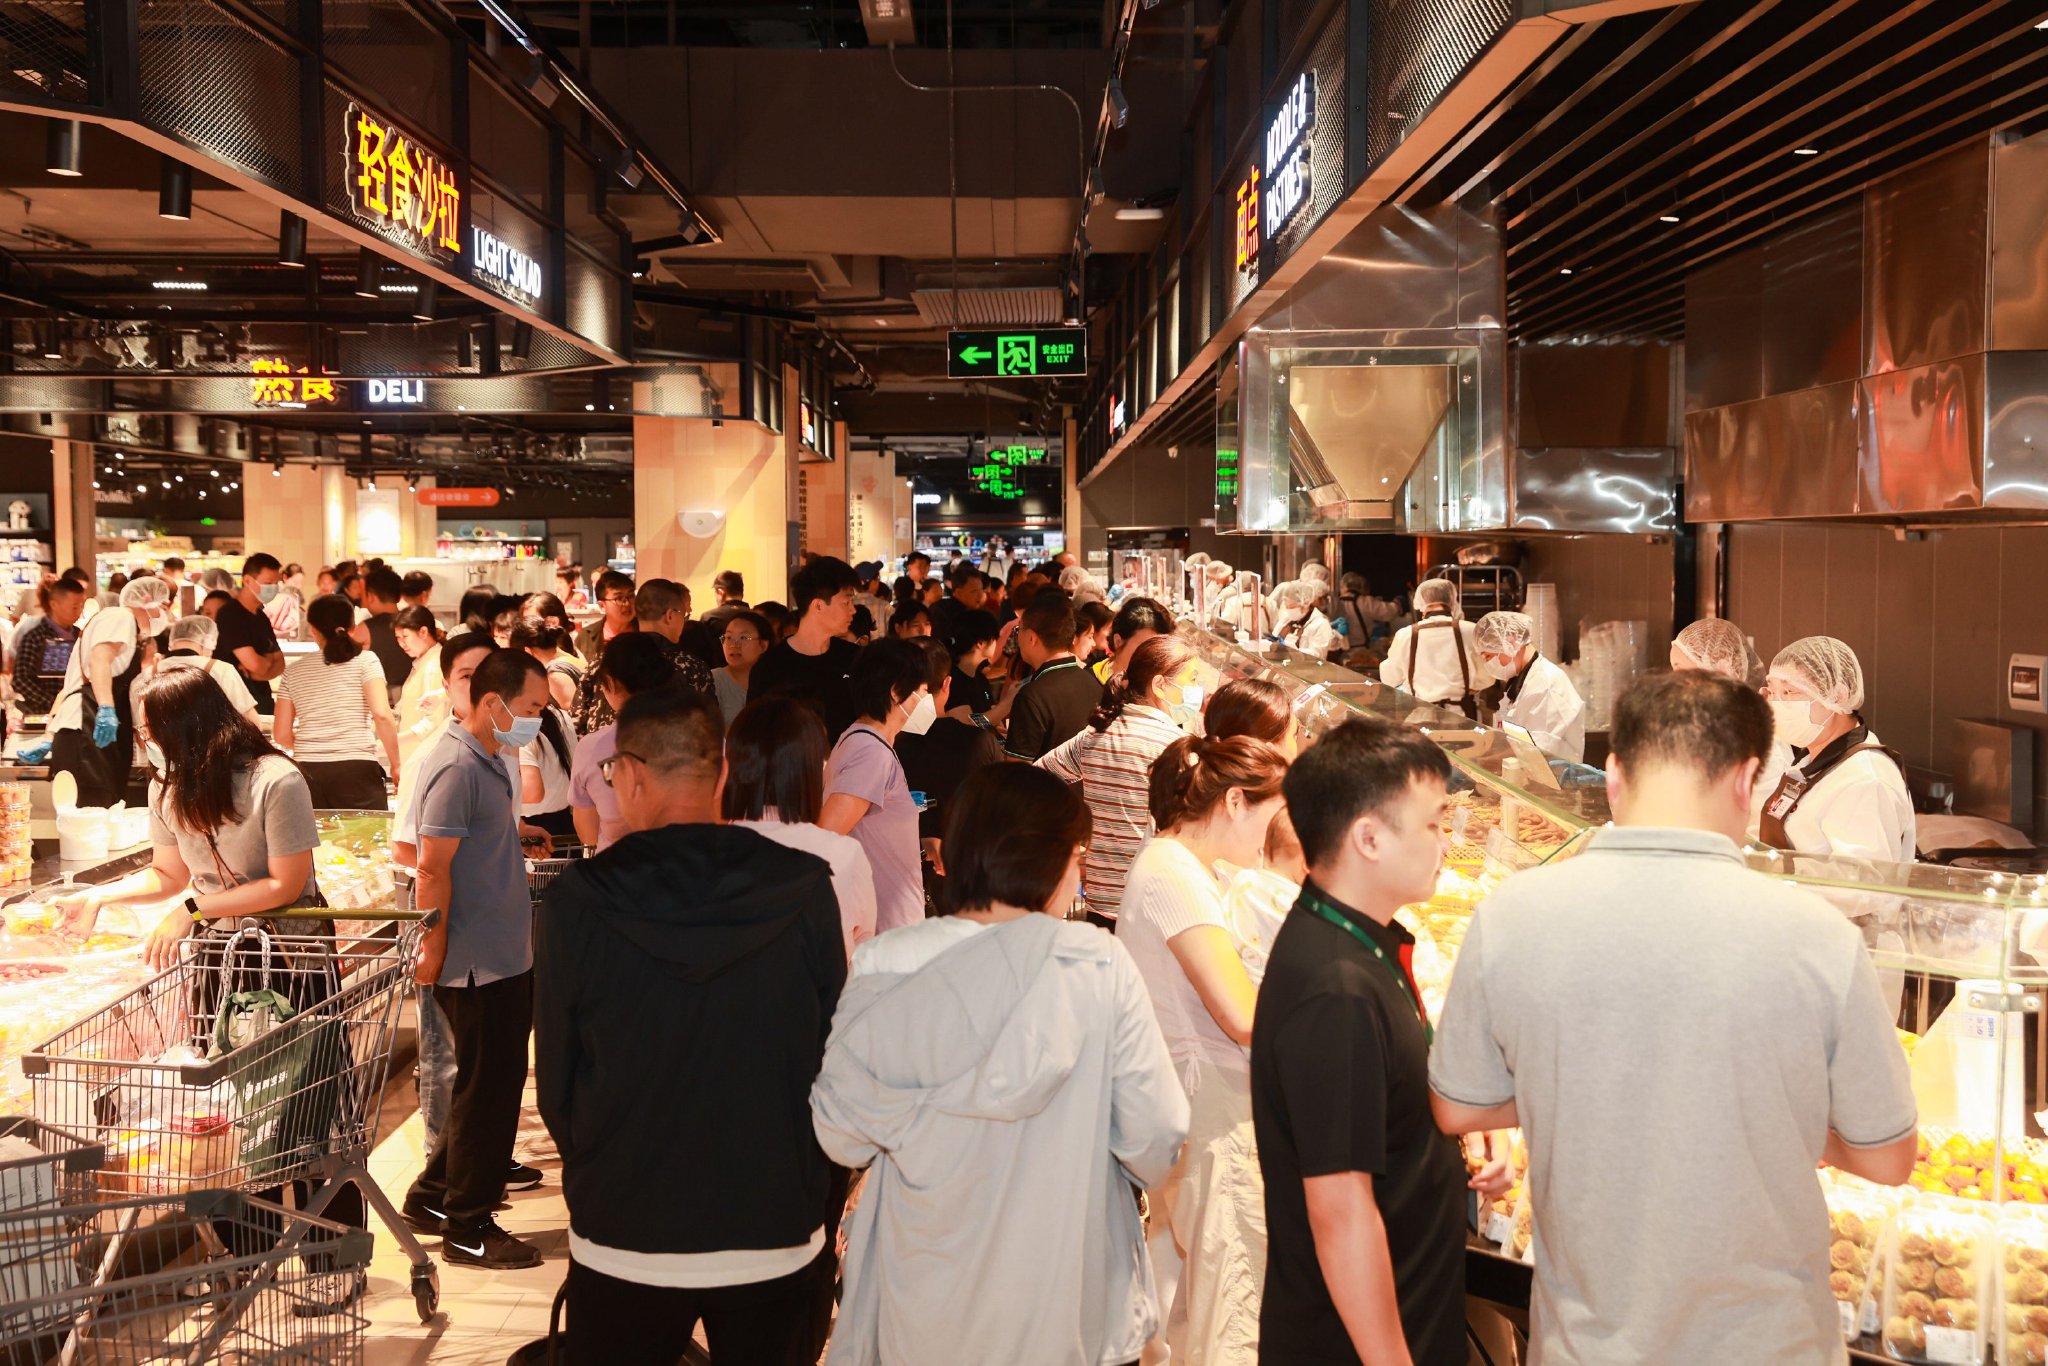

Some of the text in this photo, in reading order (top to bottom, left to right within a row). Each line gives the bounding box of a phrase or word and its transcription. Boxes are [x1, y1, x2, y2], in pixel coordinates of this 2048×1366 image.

[357, 111, 461, 254] 轻食沙拉
[1236, 164, 1260, 272] 面点
[1266, 145, 1303, 240] PASTRIES
[473, 227, 542, 298] LIGHT SALAD
[1042, 344, 1074, 355] 安全出口
[1046, 355, 1070, 364] EXIT
[368, 379, 424, 403] DELI
